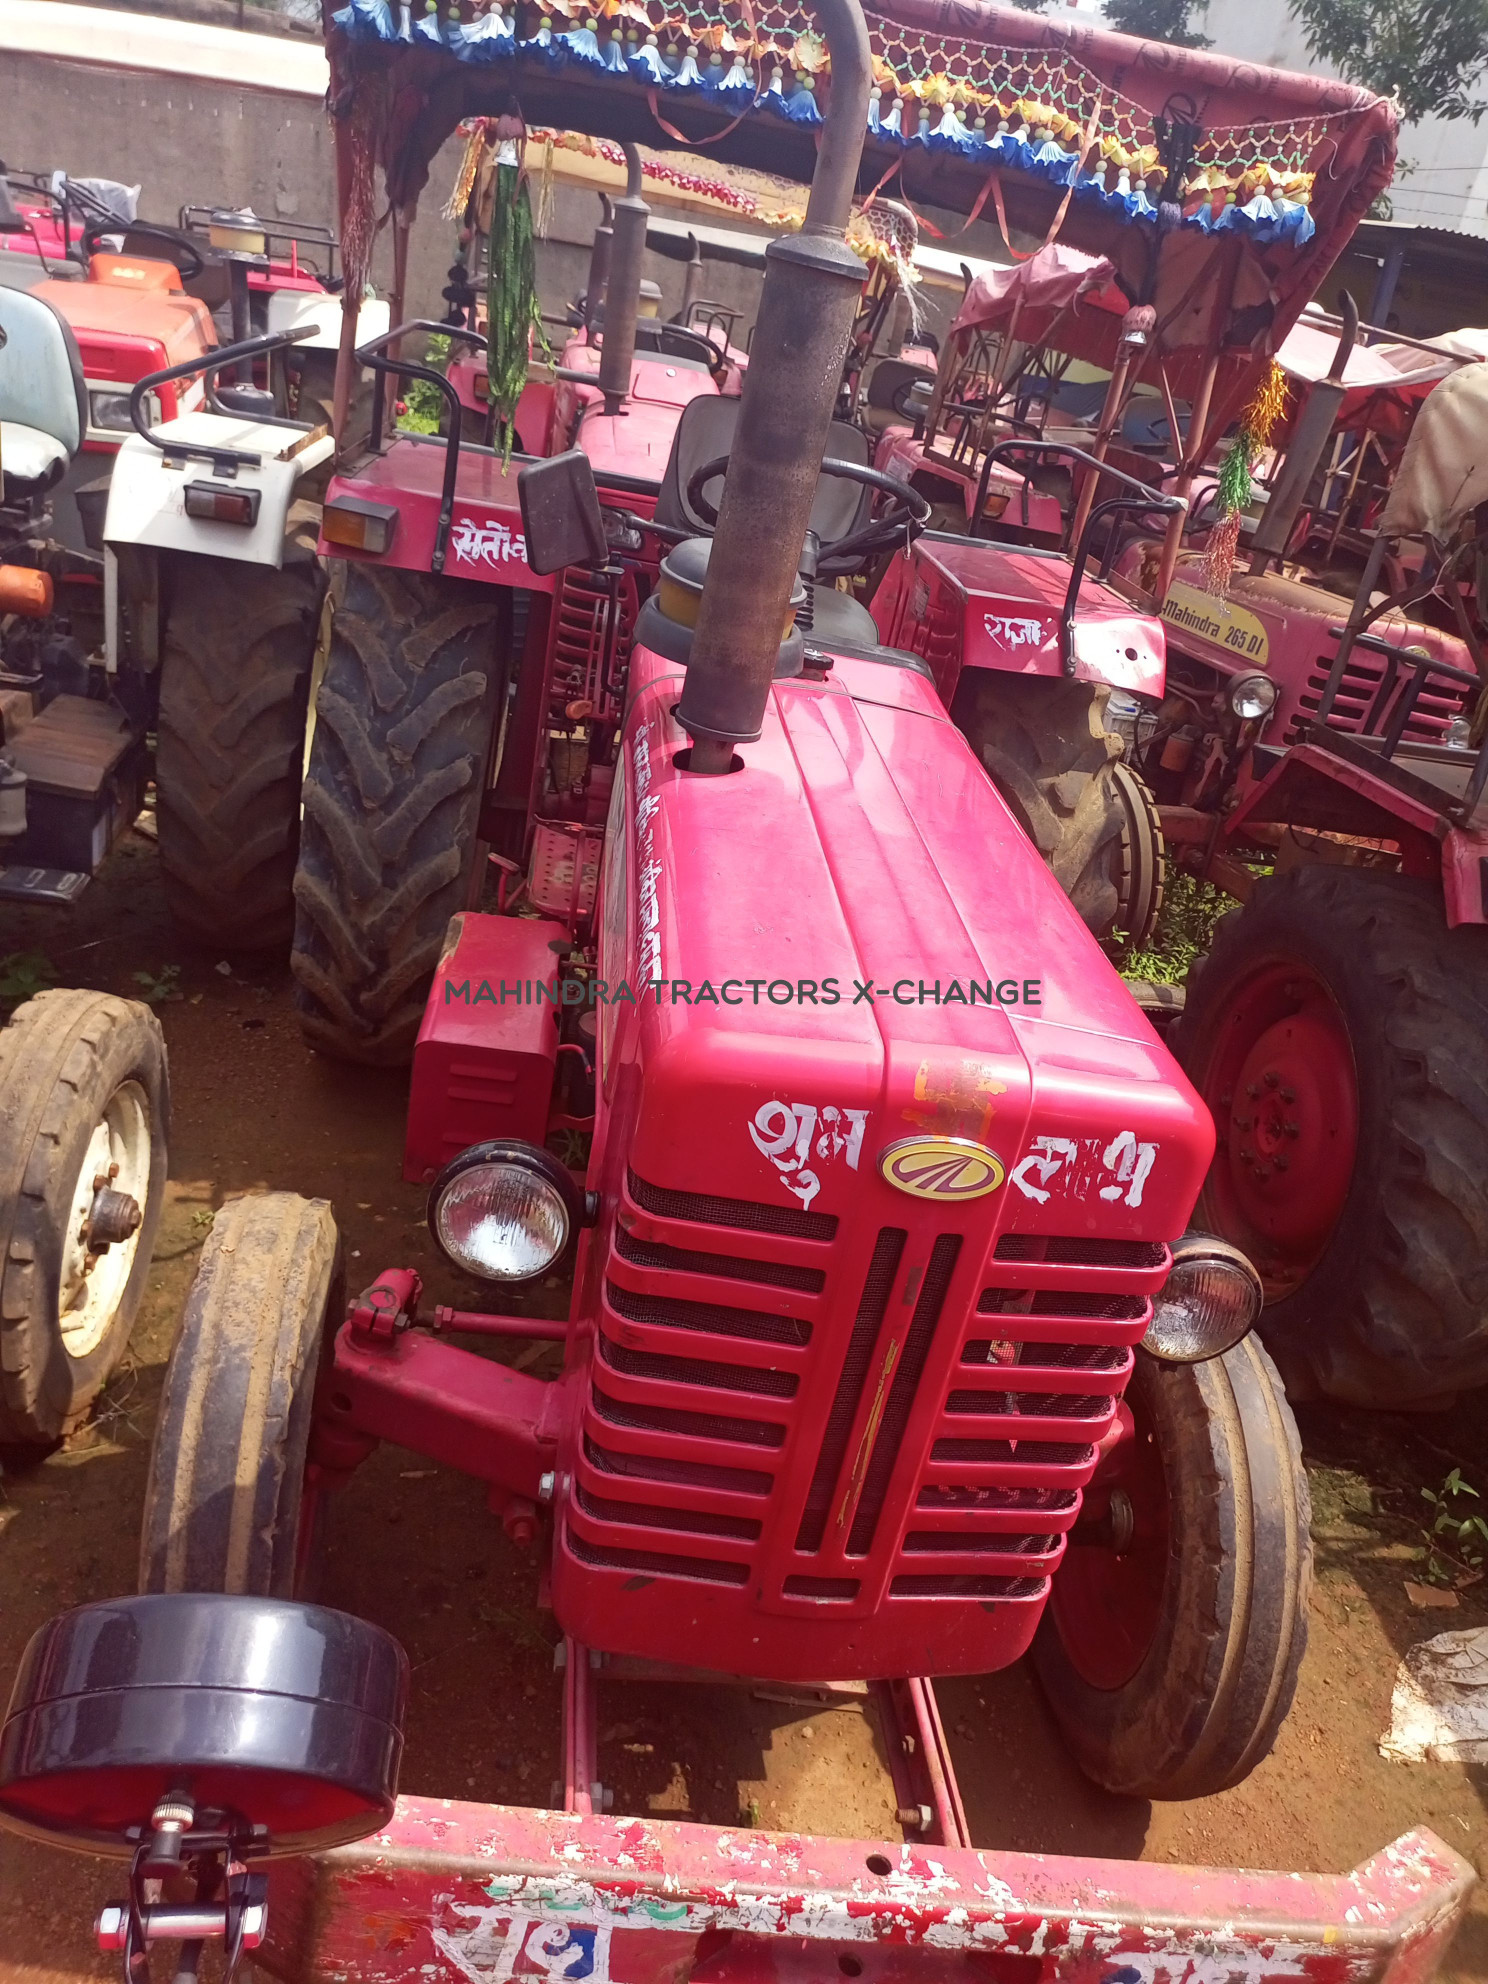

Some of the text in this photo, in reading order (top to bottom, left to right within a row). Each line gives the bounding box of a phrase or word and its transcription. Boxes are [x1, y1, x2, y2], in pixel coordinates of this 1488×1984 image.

[1163, 599, 1264, 655] Mahindra 265 DI
